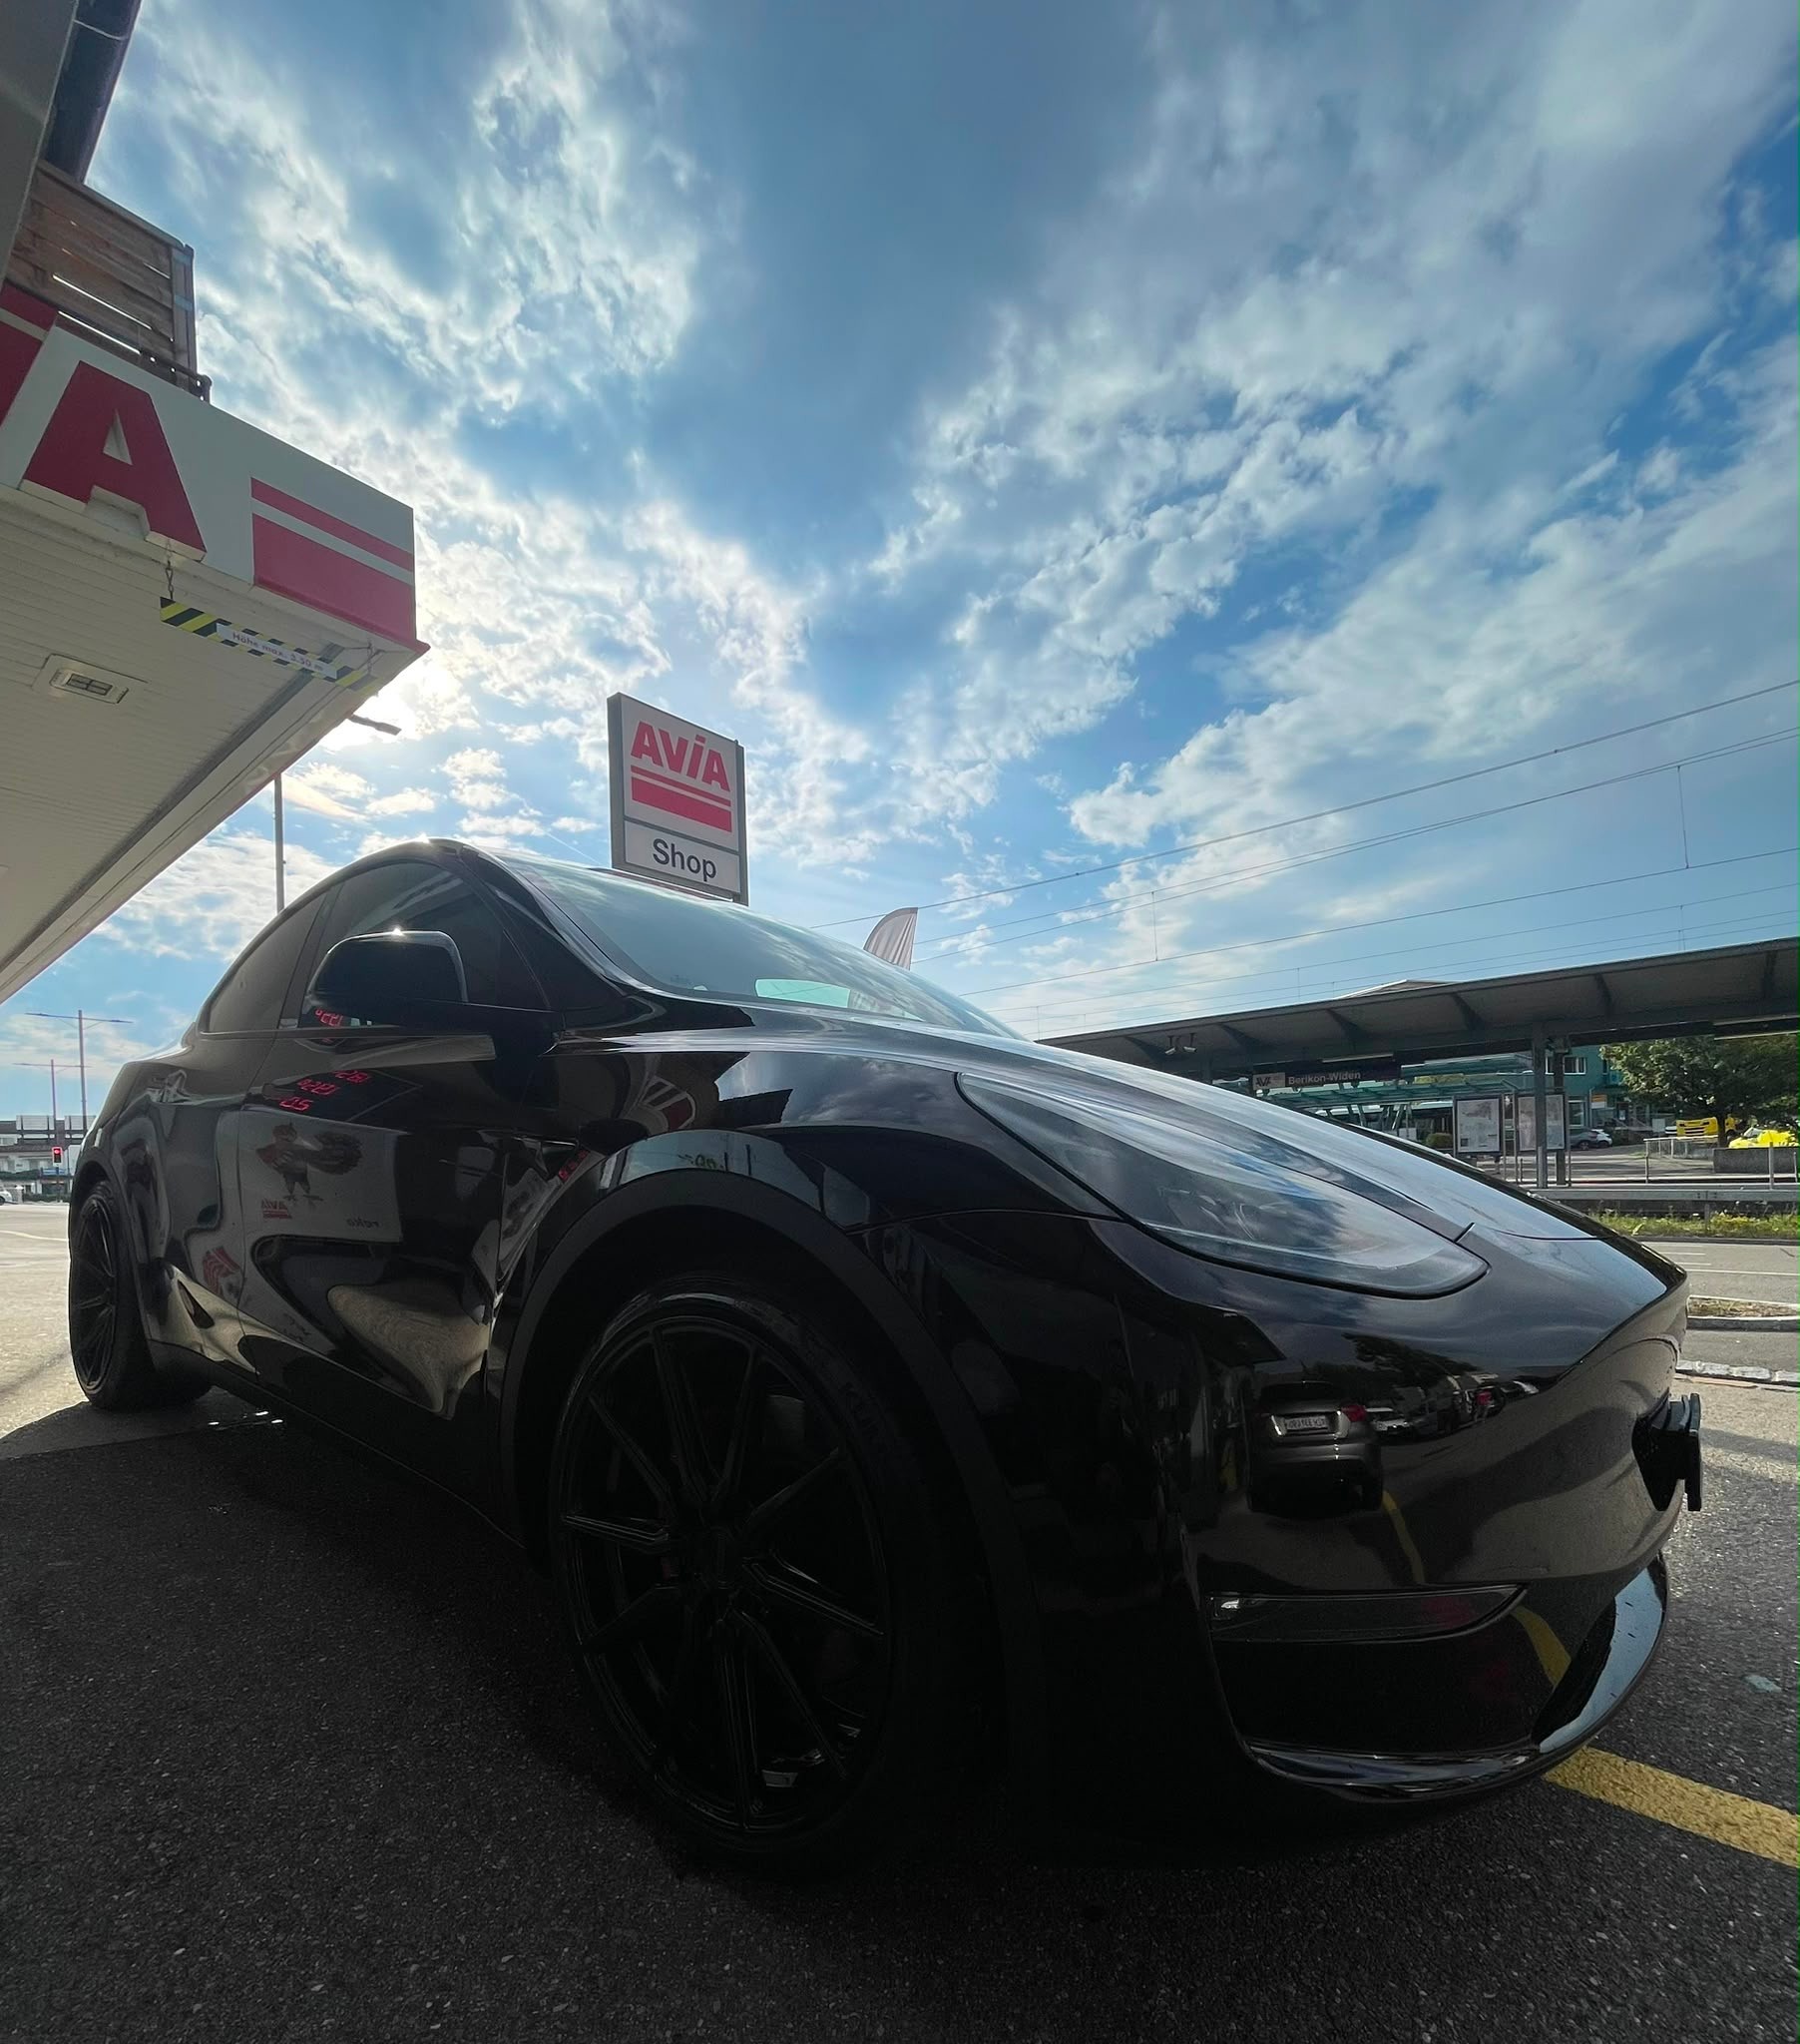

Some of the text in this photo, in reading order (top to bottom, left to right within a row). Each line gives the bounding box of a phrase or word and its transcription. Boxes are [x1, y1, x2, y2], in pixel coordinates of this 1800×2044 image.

[232, 632, 259, 649] Höhe
[653, 838, 716, 882] Shop
[1288, 1072, 1361, 1085] Berikon-Widen
